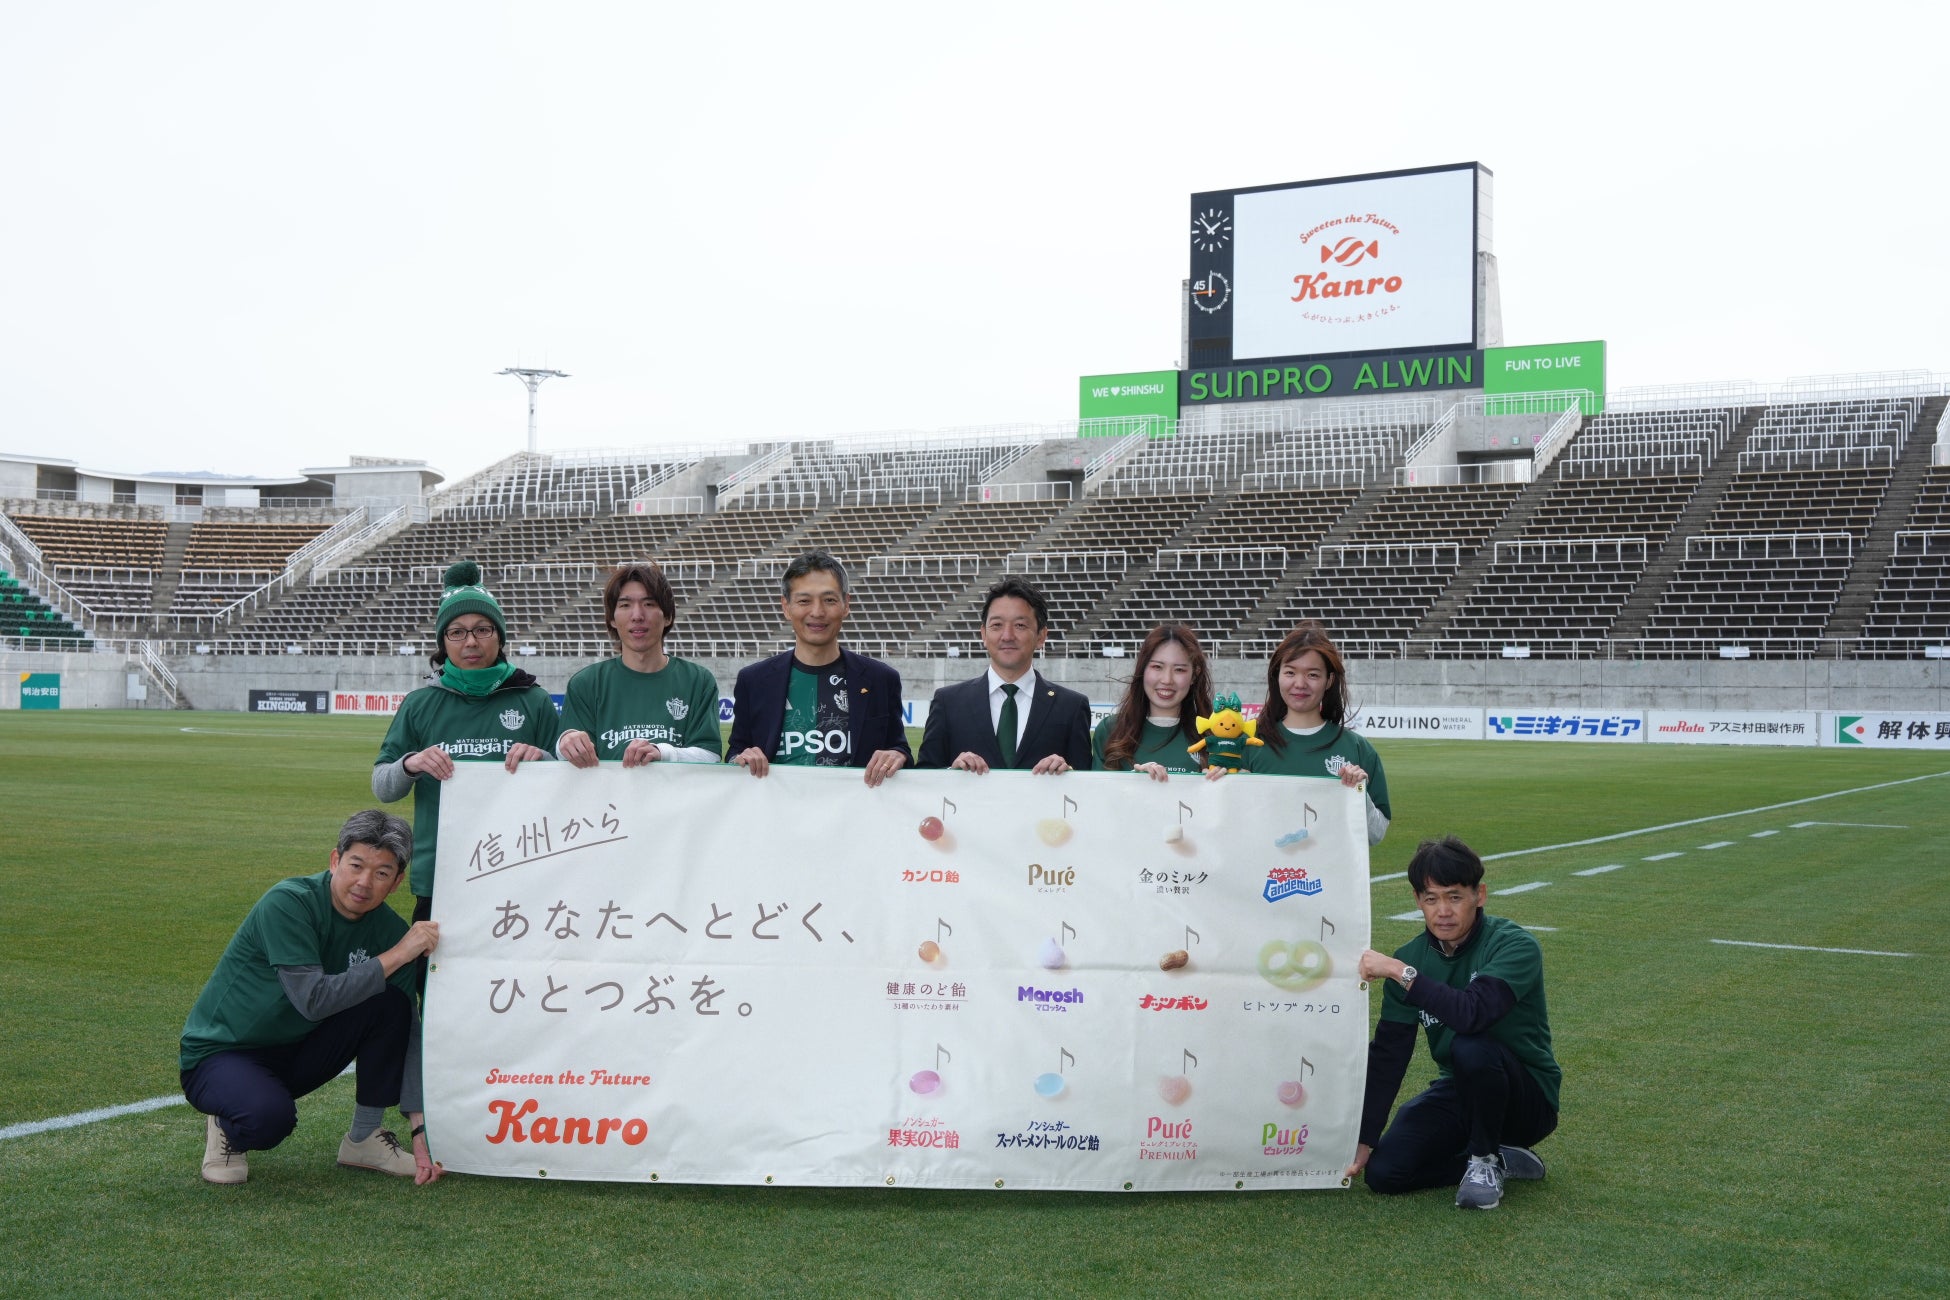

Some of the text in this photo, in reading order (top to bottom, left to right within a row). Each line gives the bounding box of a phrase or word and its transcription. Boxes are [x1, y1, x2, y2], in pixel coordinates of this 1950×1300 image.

[1300, 213, 1400, 244] Sweeten the Future
[1193, 280, 1206, 291] 45
[1291, 271, 1402, 302] Kanro
[1505, 356, 1581, 371] FUN TO LIVE
[1353, 356, 1472, 390] ALWIN
[1092, 384, 1164, 398] WE SHINSHU
[22, 687, 59, 696] 明治安田
[257, 700, 307, 711] KINGDOM
[1366, 716, 1440, 729] AZUMINO
[1513, 715, 1641, 737] 三洋グラビア
[1709, 721, 1805, 734] アズミ村田製作所
[469, 804, 620, 872] 信州から
[902, 869, 960, 884] カンロ飴
[1028, 863, 1075, 886] Puré
[1138, 867, 1209, 885] 金のミルク
[1263, 878, 1323, 903] Candemina
[491, 899, 855, 943] あなたへとどく、
[489, 974, 753, 1017] ひとつぶを。
[886, 981, 967, 998] 健康のど飴
[1017, 986, 1084, 1004] Marosh
[1035, 1004, 1067, 1012] マロッシュ
[1138, 993, 1208, 1012] ナッツボン
[485, 1068, 651, 1086] Sweeten the Future
[485, 1098, 648, 1146] Kanro
[902, 1116, 945, 1128] ノンシュガー
[1026, 1120, 1071, 1132] ノンシュガー
[1147, 1116, 1193, 1139] Puré
[887, 1128, 960, 1149] 果実のど飴
[995, 1132, 1100, 1151] スーパーメントールのど飴
[1262, 1122, 1309, 1146] Puré
[1263, 1146, 1305, 1156] ピュレリング
